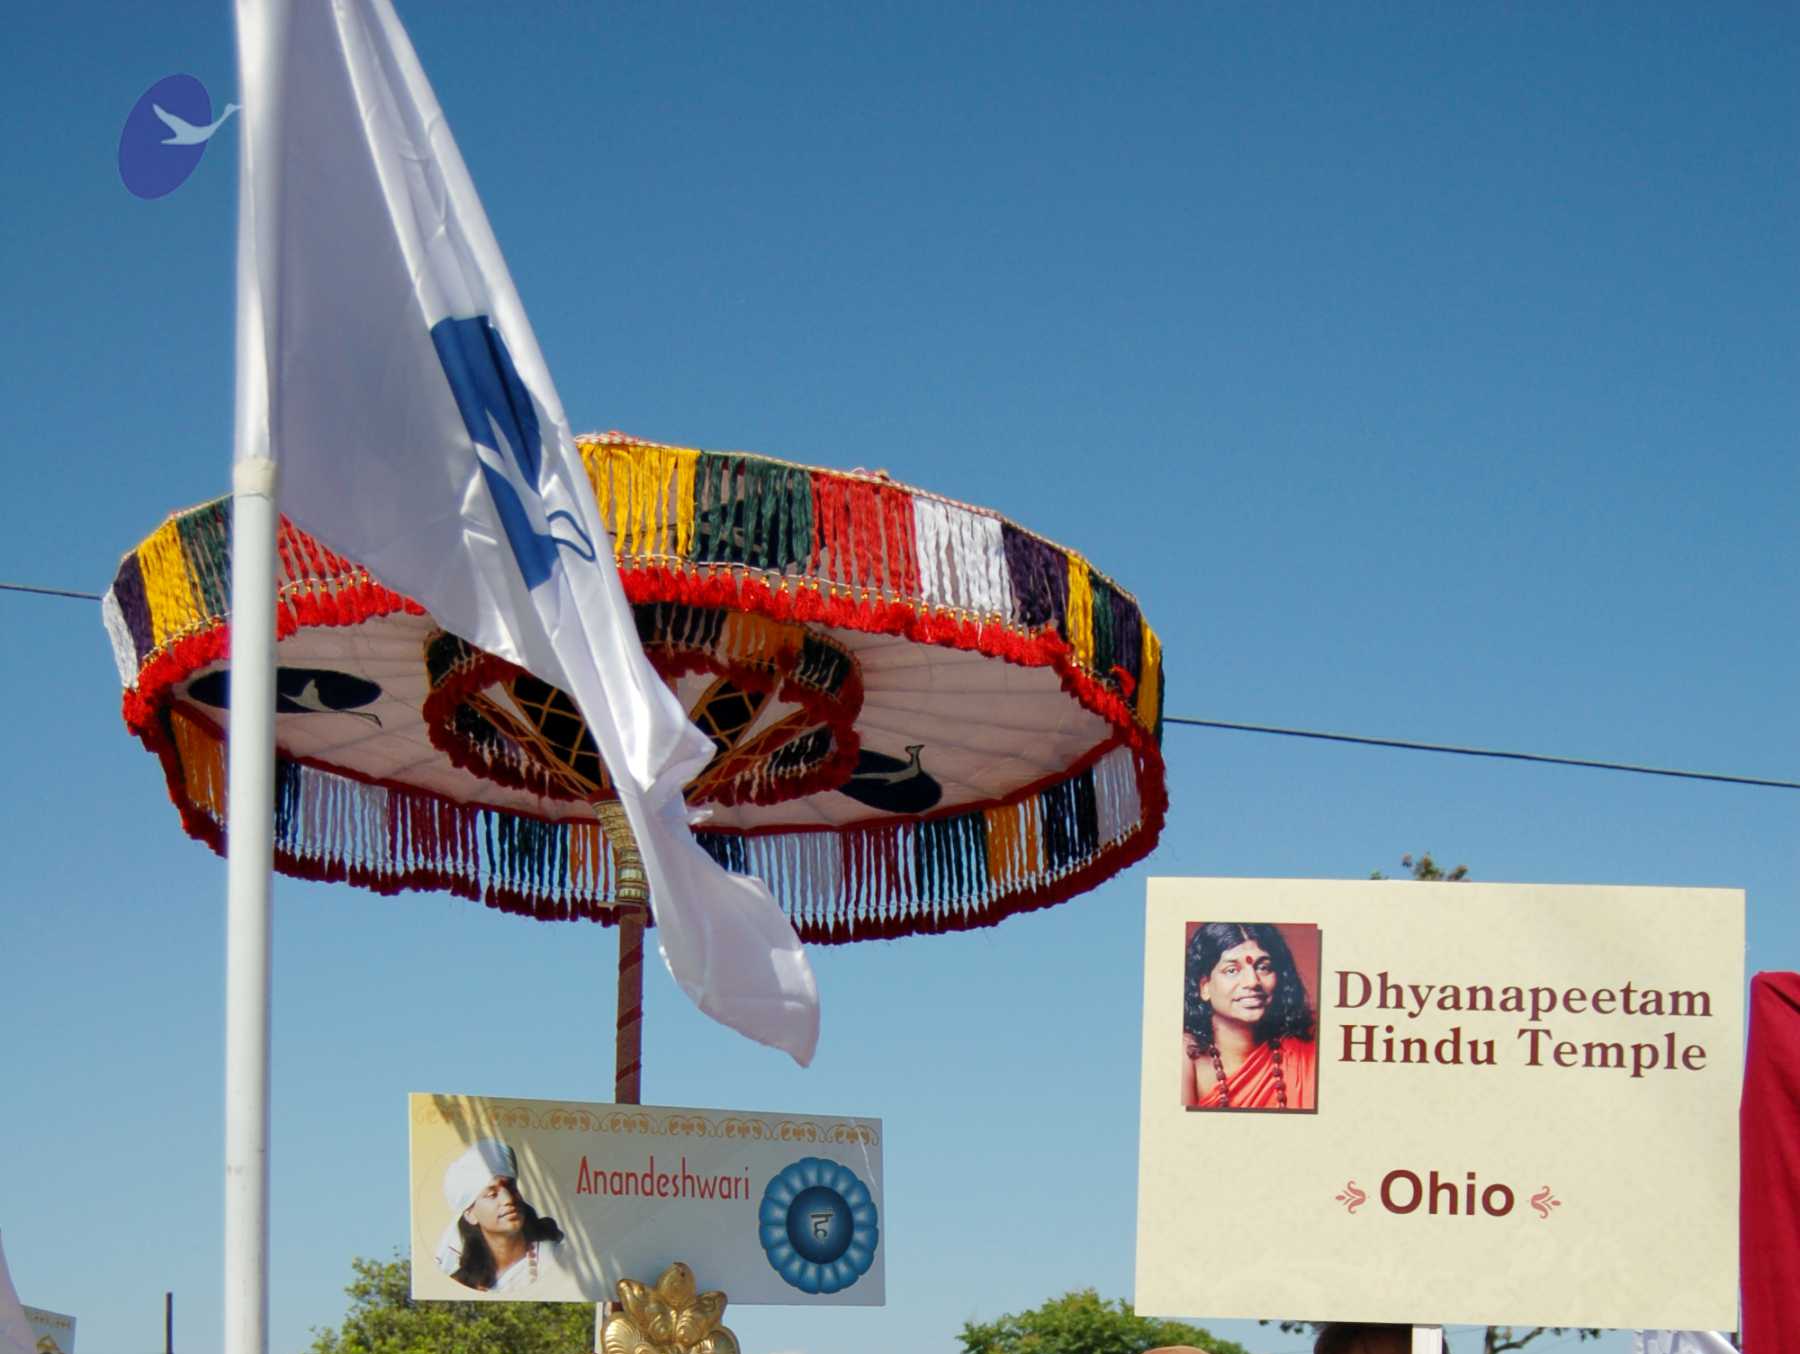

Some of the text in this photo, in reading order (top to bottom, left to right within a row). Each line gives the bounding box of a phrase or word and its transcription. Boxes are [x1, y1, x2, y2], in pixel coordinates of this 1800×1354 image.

[1333, 969, 1714, 1022] Dhyanapeetam
[1338, 1023, 1708, 1079] Hindu Temple
[575, 1154, 750, 1201] Anandeshwari
[1379, 1168, 1516, 1218] Ohio
